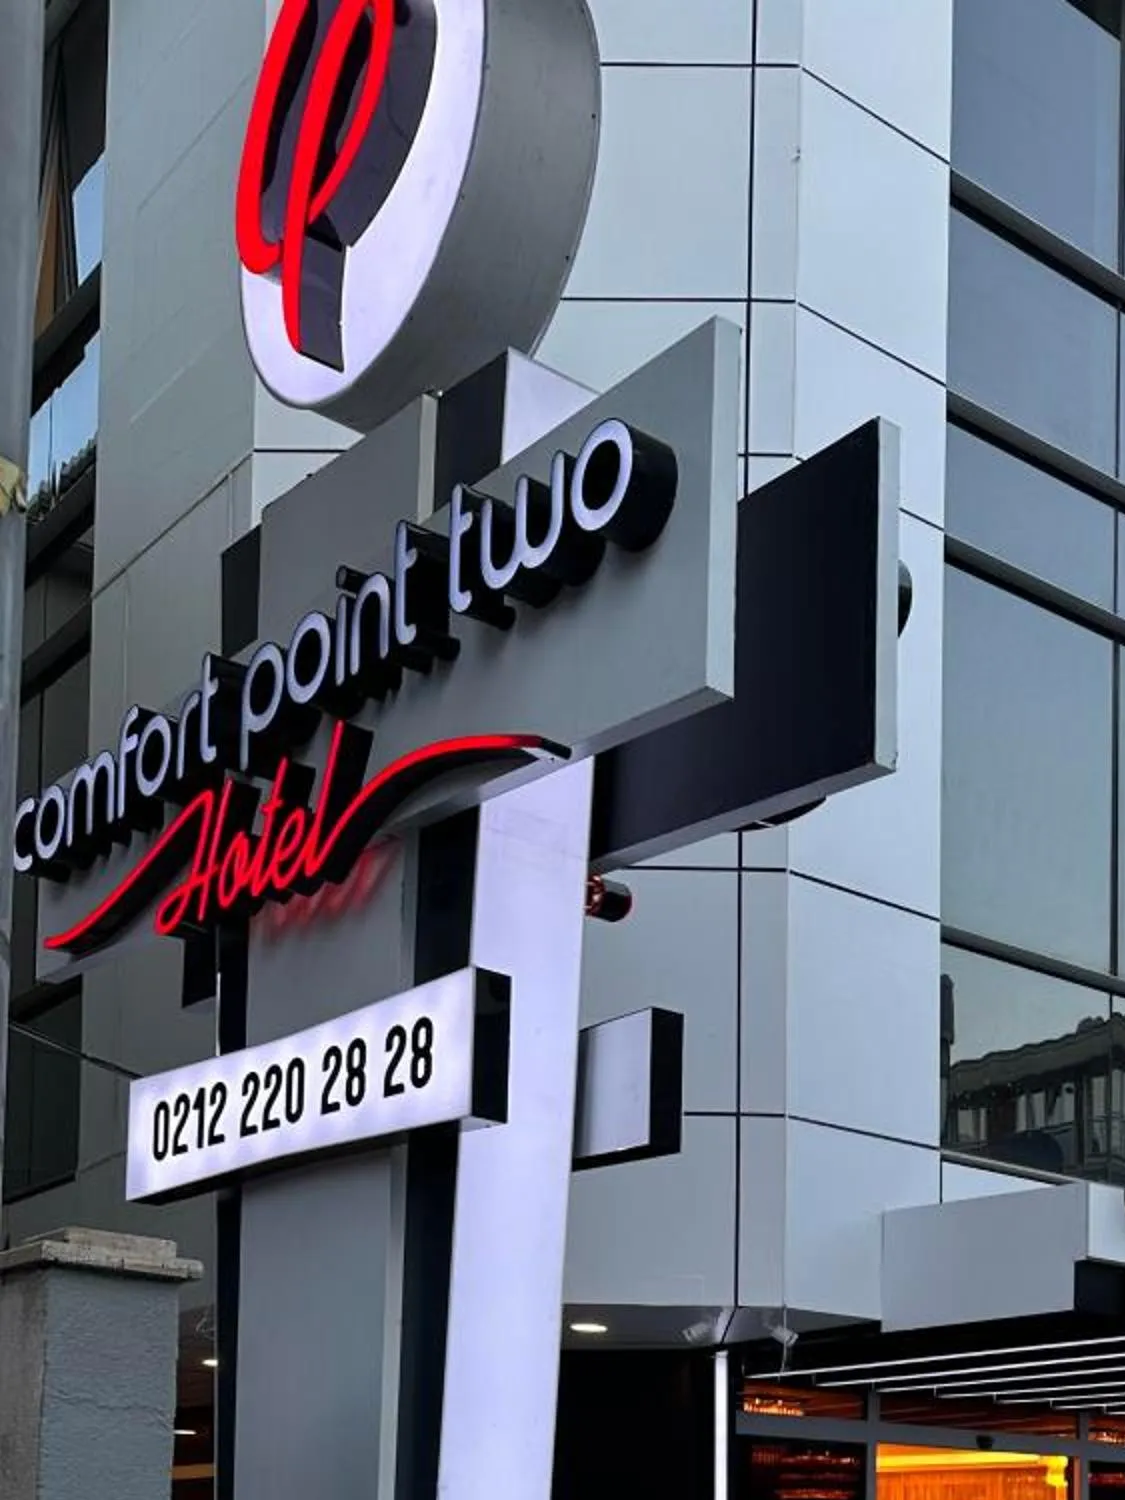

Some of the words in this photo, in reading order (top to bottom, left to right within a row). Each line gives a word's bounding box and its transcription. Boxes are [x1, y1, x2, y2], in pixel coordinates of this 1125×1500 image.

[13, 652, 219, 873] comfort
[241, 519, 416, 771] point
[450, 418, 633, 613] two
[155, 719, 348, 935] Hotel
[153, 1081, 227, 1162] 0212
[239, 1057, 305, 1139] 220
[321, 1037, 367, 1115] 28
[383, 1015, 434, 1097] 28
